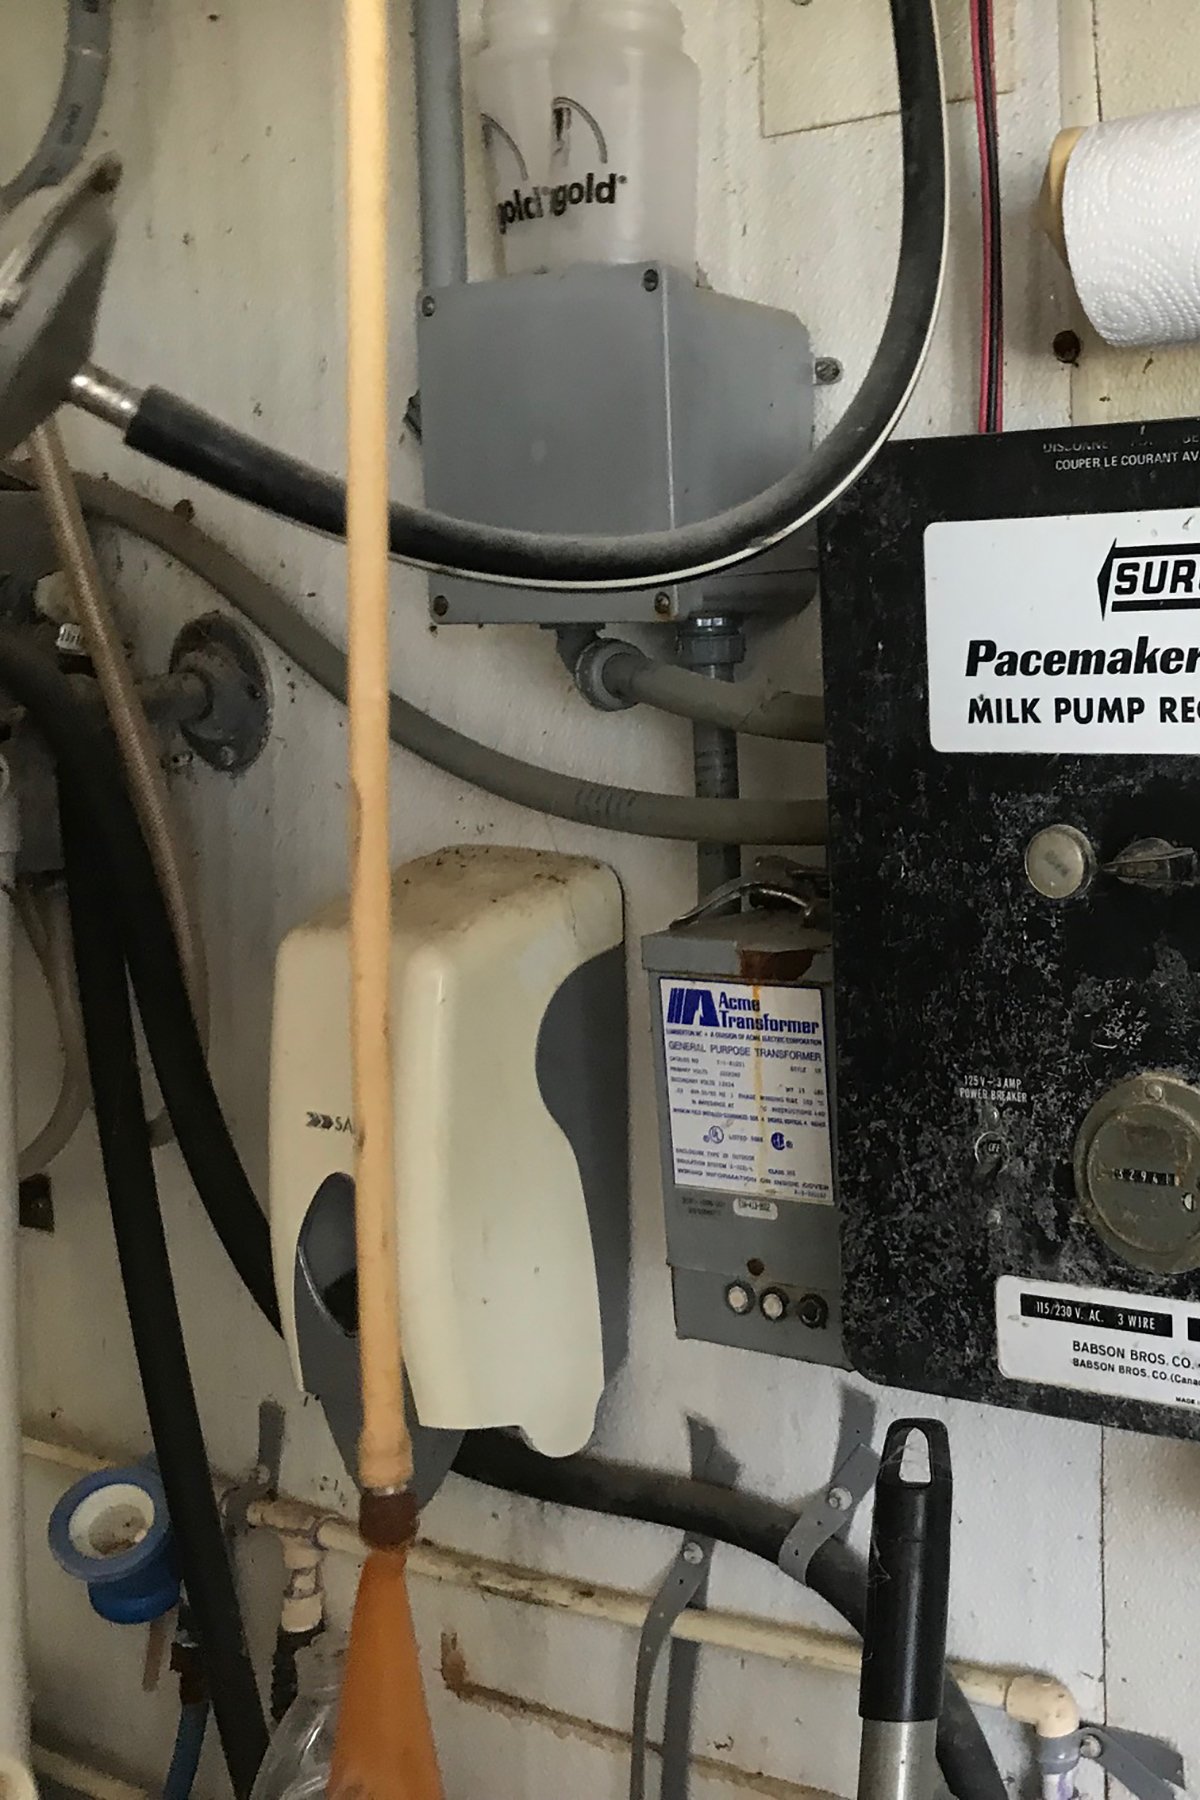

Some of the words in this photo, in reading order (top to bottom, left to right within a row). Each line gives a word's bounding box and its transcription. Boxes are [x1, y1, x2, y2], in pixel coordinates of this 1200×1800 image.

[1055, 457, 1100, 471] COUPER
[1103, 455, 1118, 468] LE
[1121, 451, 1178, 466] COURANT
[967, 696, 1042, 725] MILK
[1054, 696, 1145, 724] PUMP
[719, 991, 761, 1012] Acme
[719, 1009, 819, 1035] Transformer
[668, 1041, 707, 1053] GENERAL
[710, 1044, 751, 1057] PURPOSE
[754, 1047, 822, 1062] TRANSFORMER
[960, 1087, 988, 1099] POWER
[990, 1089, 1028, 1103] BREAKER
[1036, 1301, 1072, 1319] 115/230
[1117, 1313, 1124, 1326] 3
[1127, 1315, 1156, 1331] WIRE
[1072, 1340, 1125, 1359] BABSON
[1130, 1349, 1169, 1366] BROS.
[1072, 1358, 1115, 1373] BABSON
[1118, 1365, 1149, 1378] BROS.
